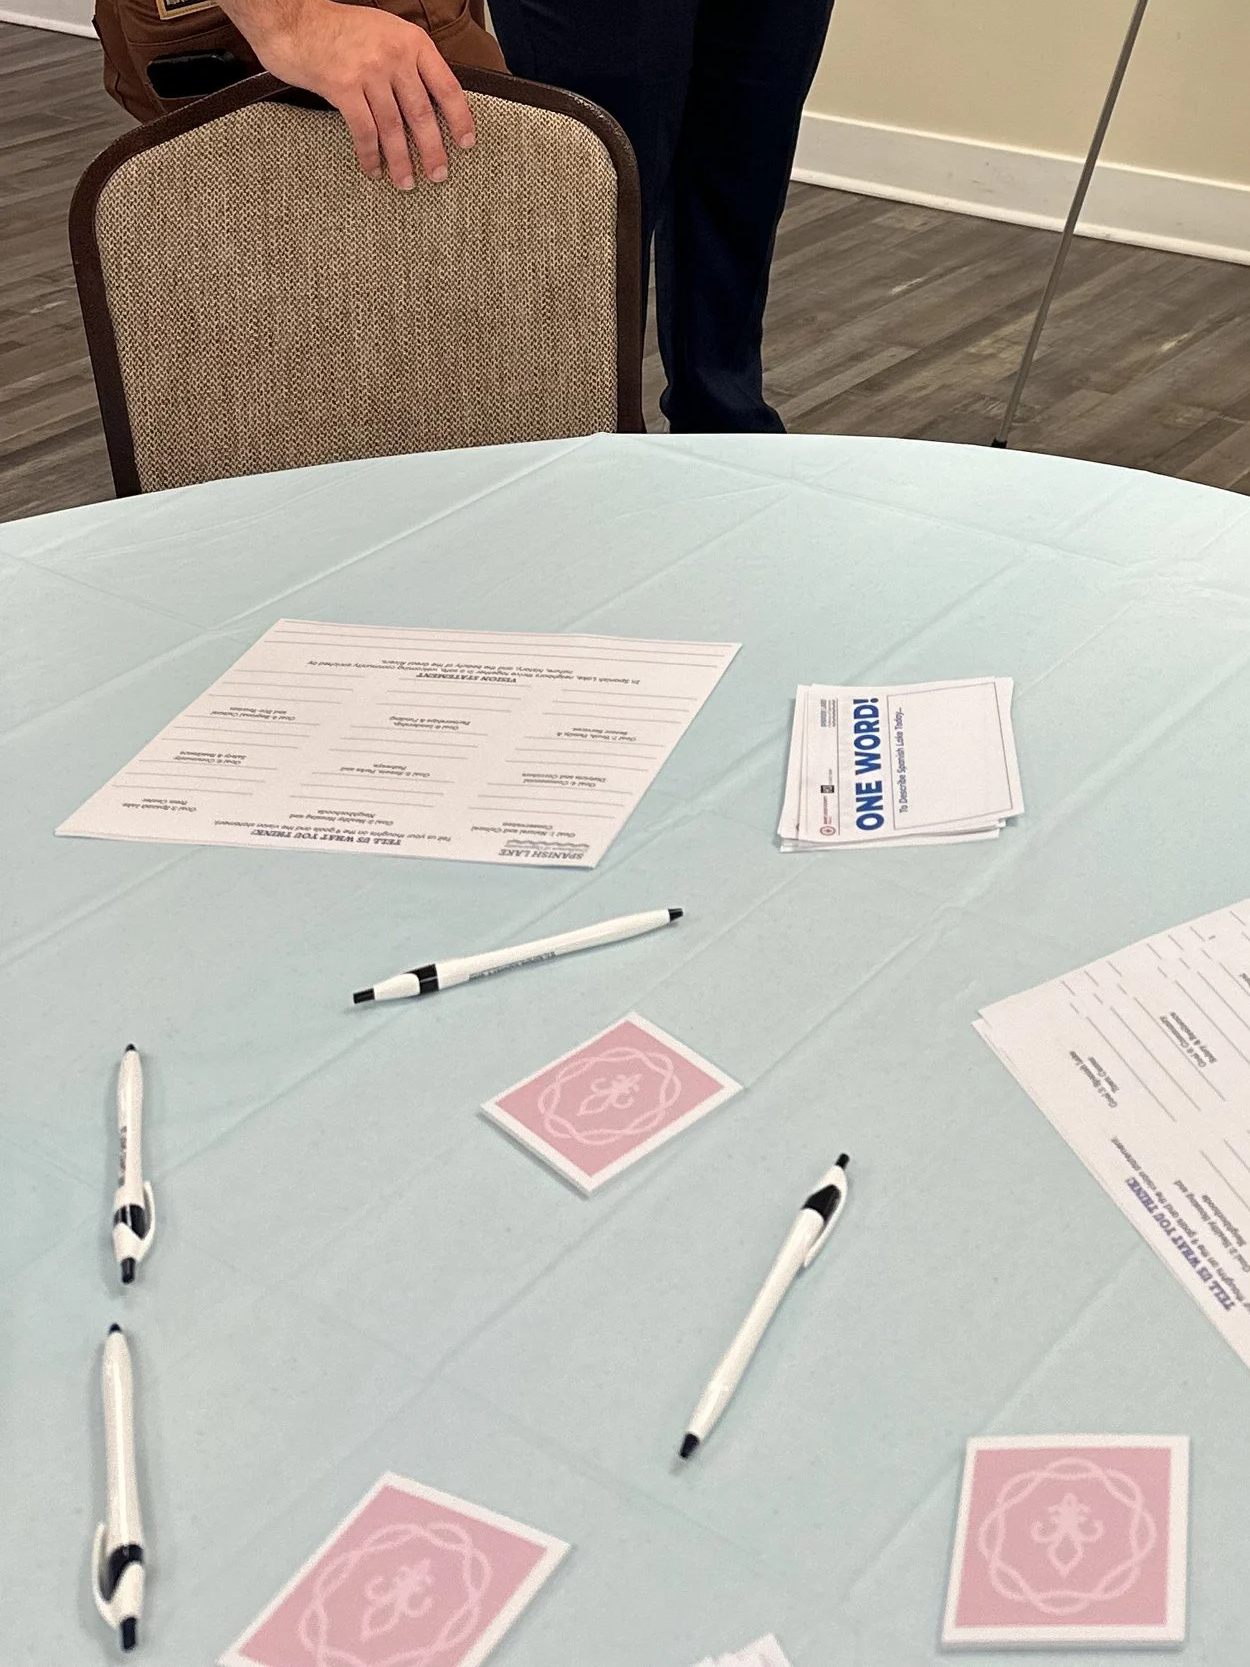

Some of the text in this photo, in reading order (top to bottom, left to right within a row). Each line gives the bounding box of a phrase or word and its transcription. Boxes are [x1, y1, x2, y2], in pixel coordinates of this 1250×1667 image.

[415, 672, 480, 680] STATEMENT
[894, 731, 904, 746] Lake
[853, 698, 884, 831] ONE WORD!
[895, 747, 907, 773] Spanish
[896, 774, 908, 803] Describe
[898, 804, 908, 813] To
[293, 832, 318, 840] YOU
[319, 833, 354, 842] WHAT
[355, 836, 371, 844] US
[373, 837, 401, 846] TELL
[498, 848, 584, 859] SPANISH LAKE
[1152, 1212, 1176, 1236] YOU
[1170, 1235, 1201, 1269] WHAT
[1196, 1266, 1213, 1283] US
[1208, 1280, 1235, 1311] TELL
